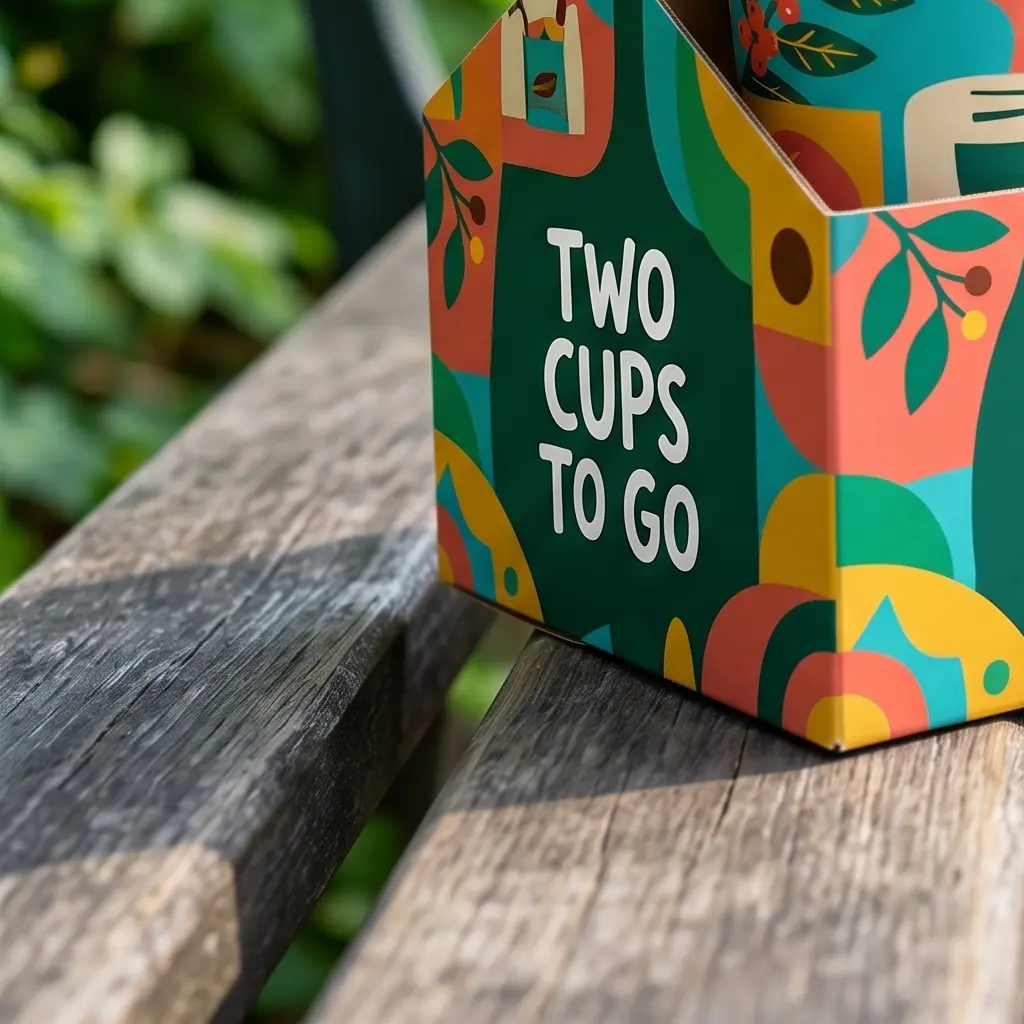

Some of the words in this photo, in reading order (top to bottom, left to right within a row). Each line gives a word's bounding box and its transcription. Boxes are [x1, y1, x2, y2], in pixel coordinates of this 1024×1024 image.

[546, 227, 676, 341] TWO
[543, 337, 690, 464] CUPS
[538, 442, 607, 542] TO
[623, 468, 701, 573] GO
